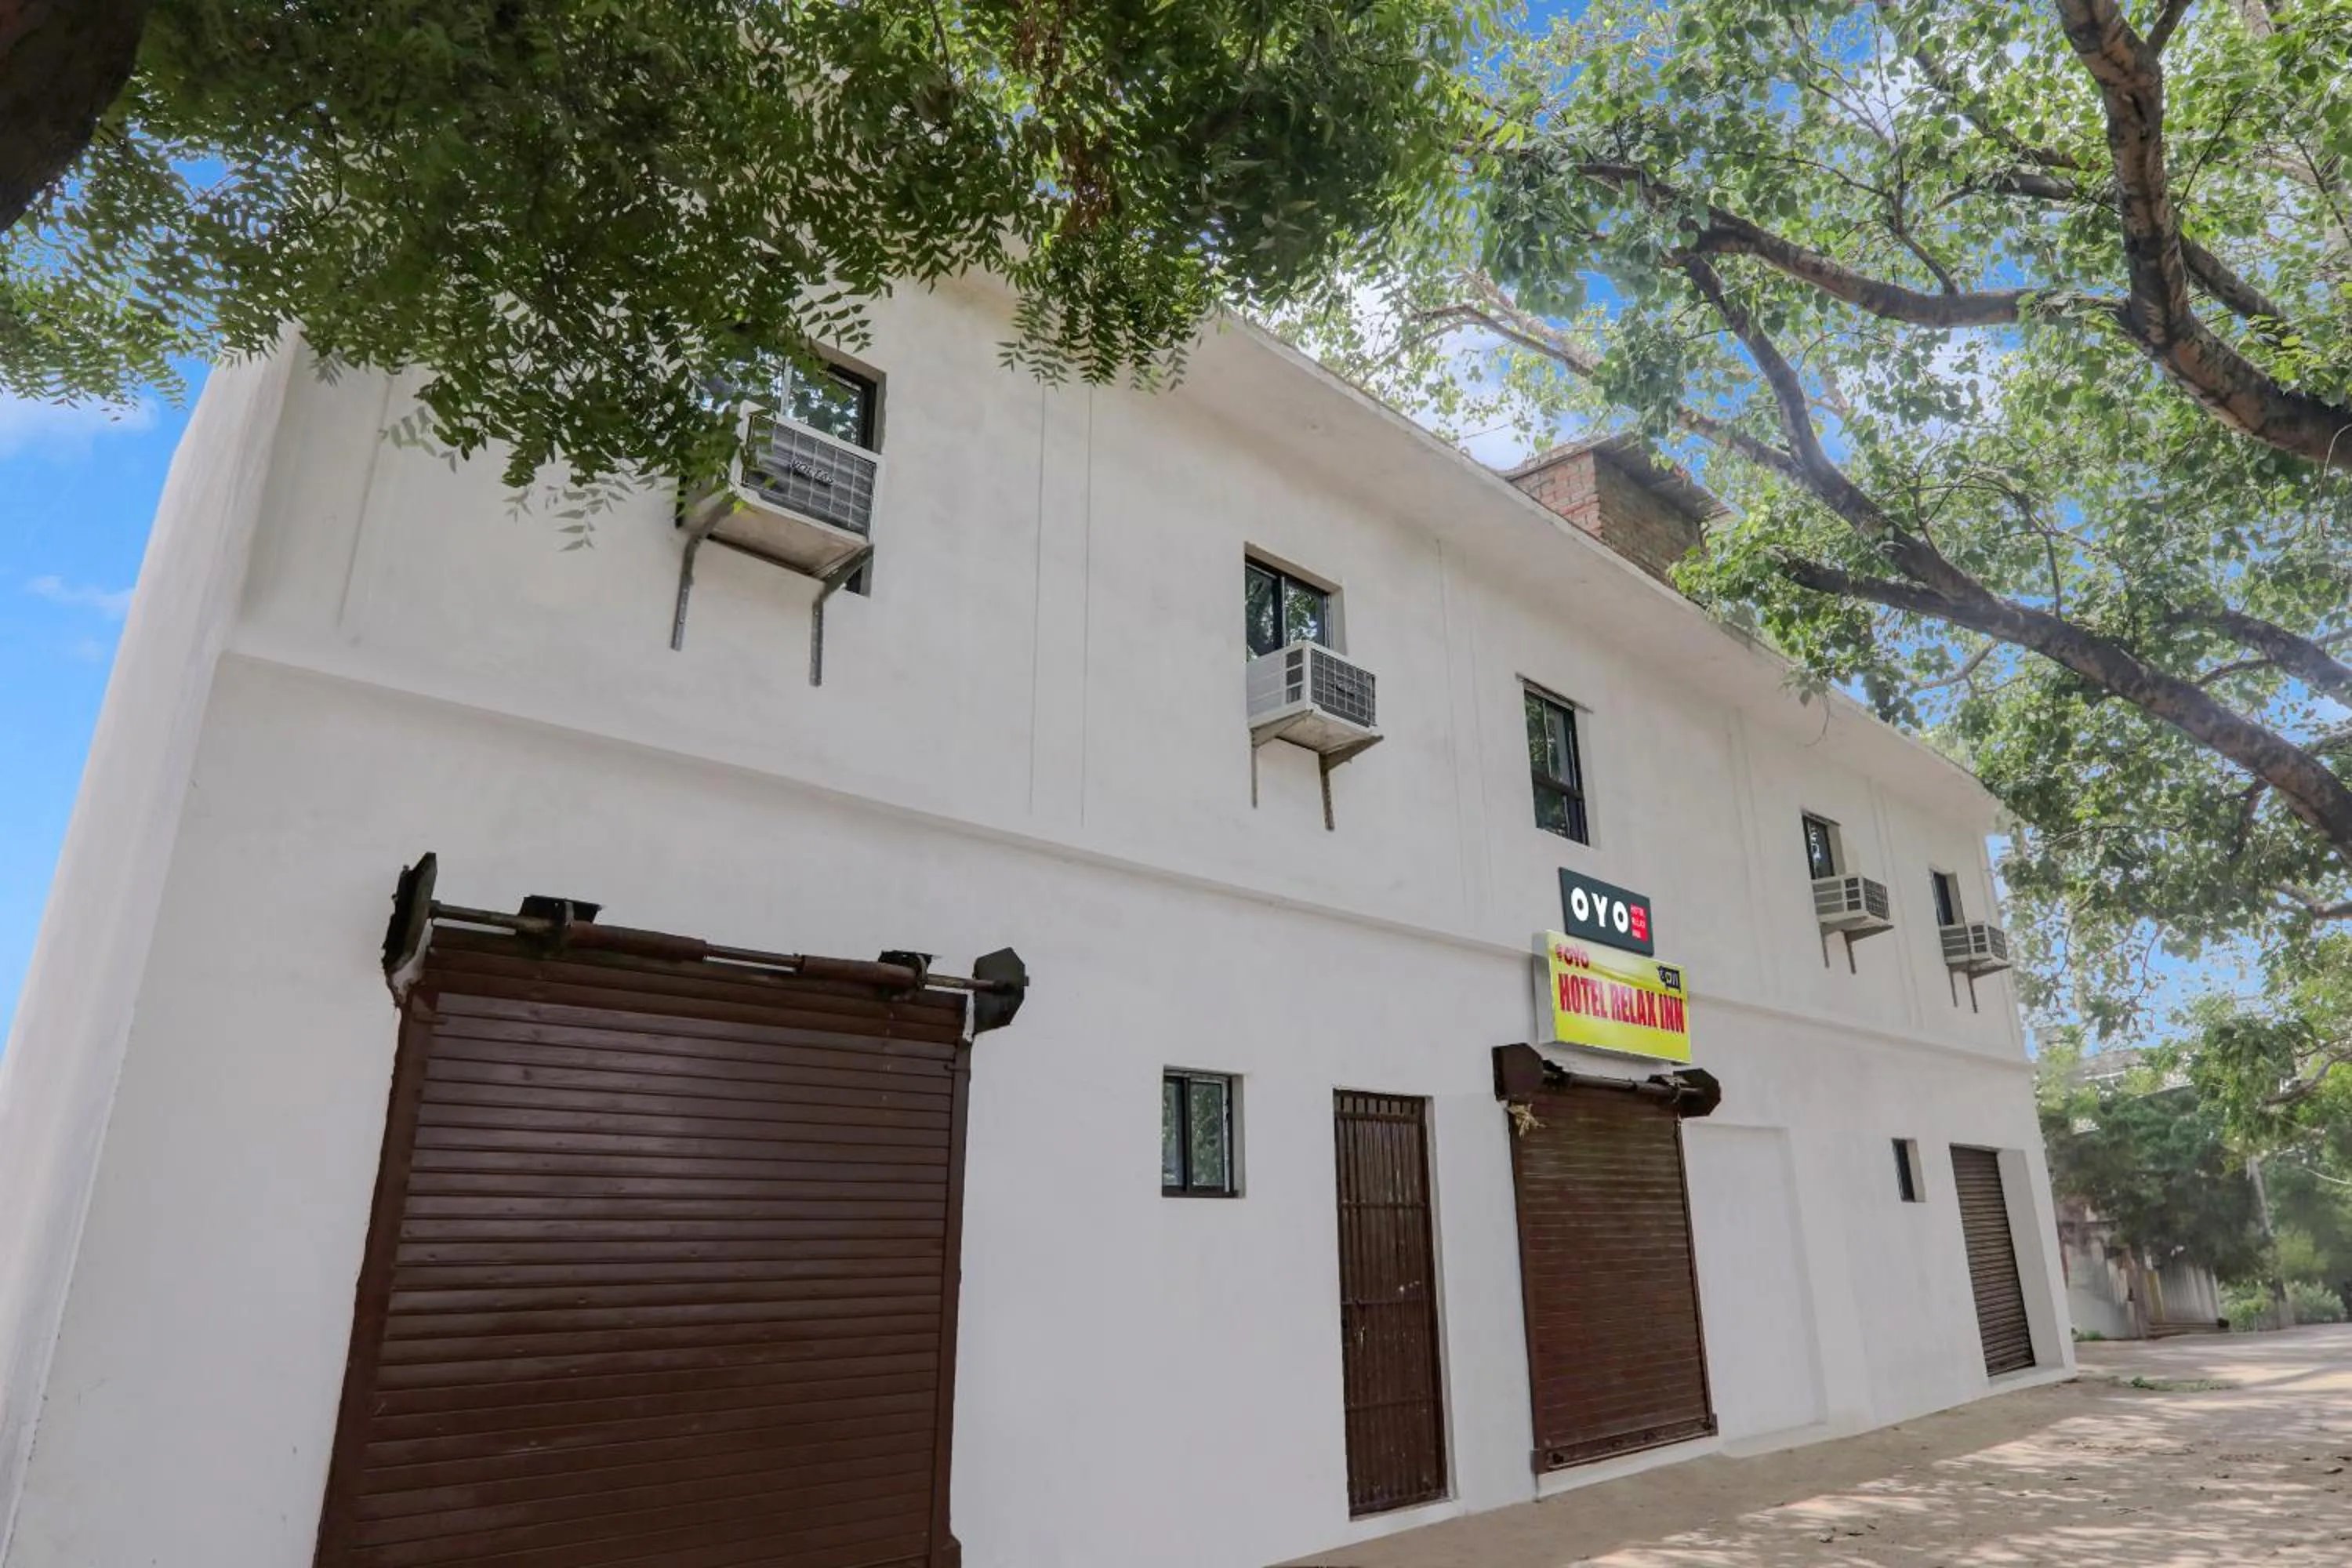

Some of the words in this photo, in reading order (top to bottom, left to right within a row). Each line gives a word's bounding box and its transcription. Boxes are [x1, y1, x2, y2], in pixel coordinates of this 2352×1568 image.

[1570, 887, 1629, 933] OYO
[1558, 973, 1607, 1018] HOTEL
[1609, 982, 1657, 1027] RELAX
[1658, 993, 1685, 1033] INN
